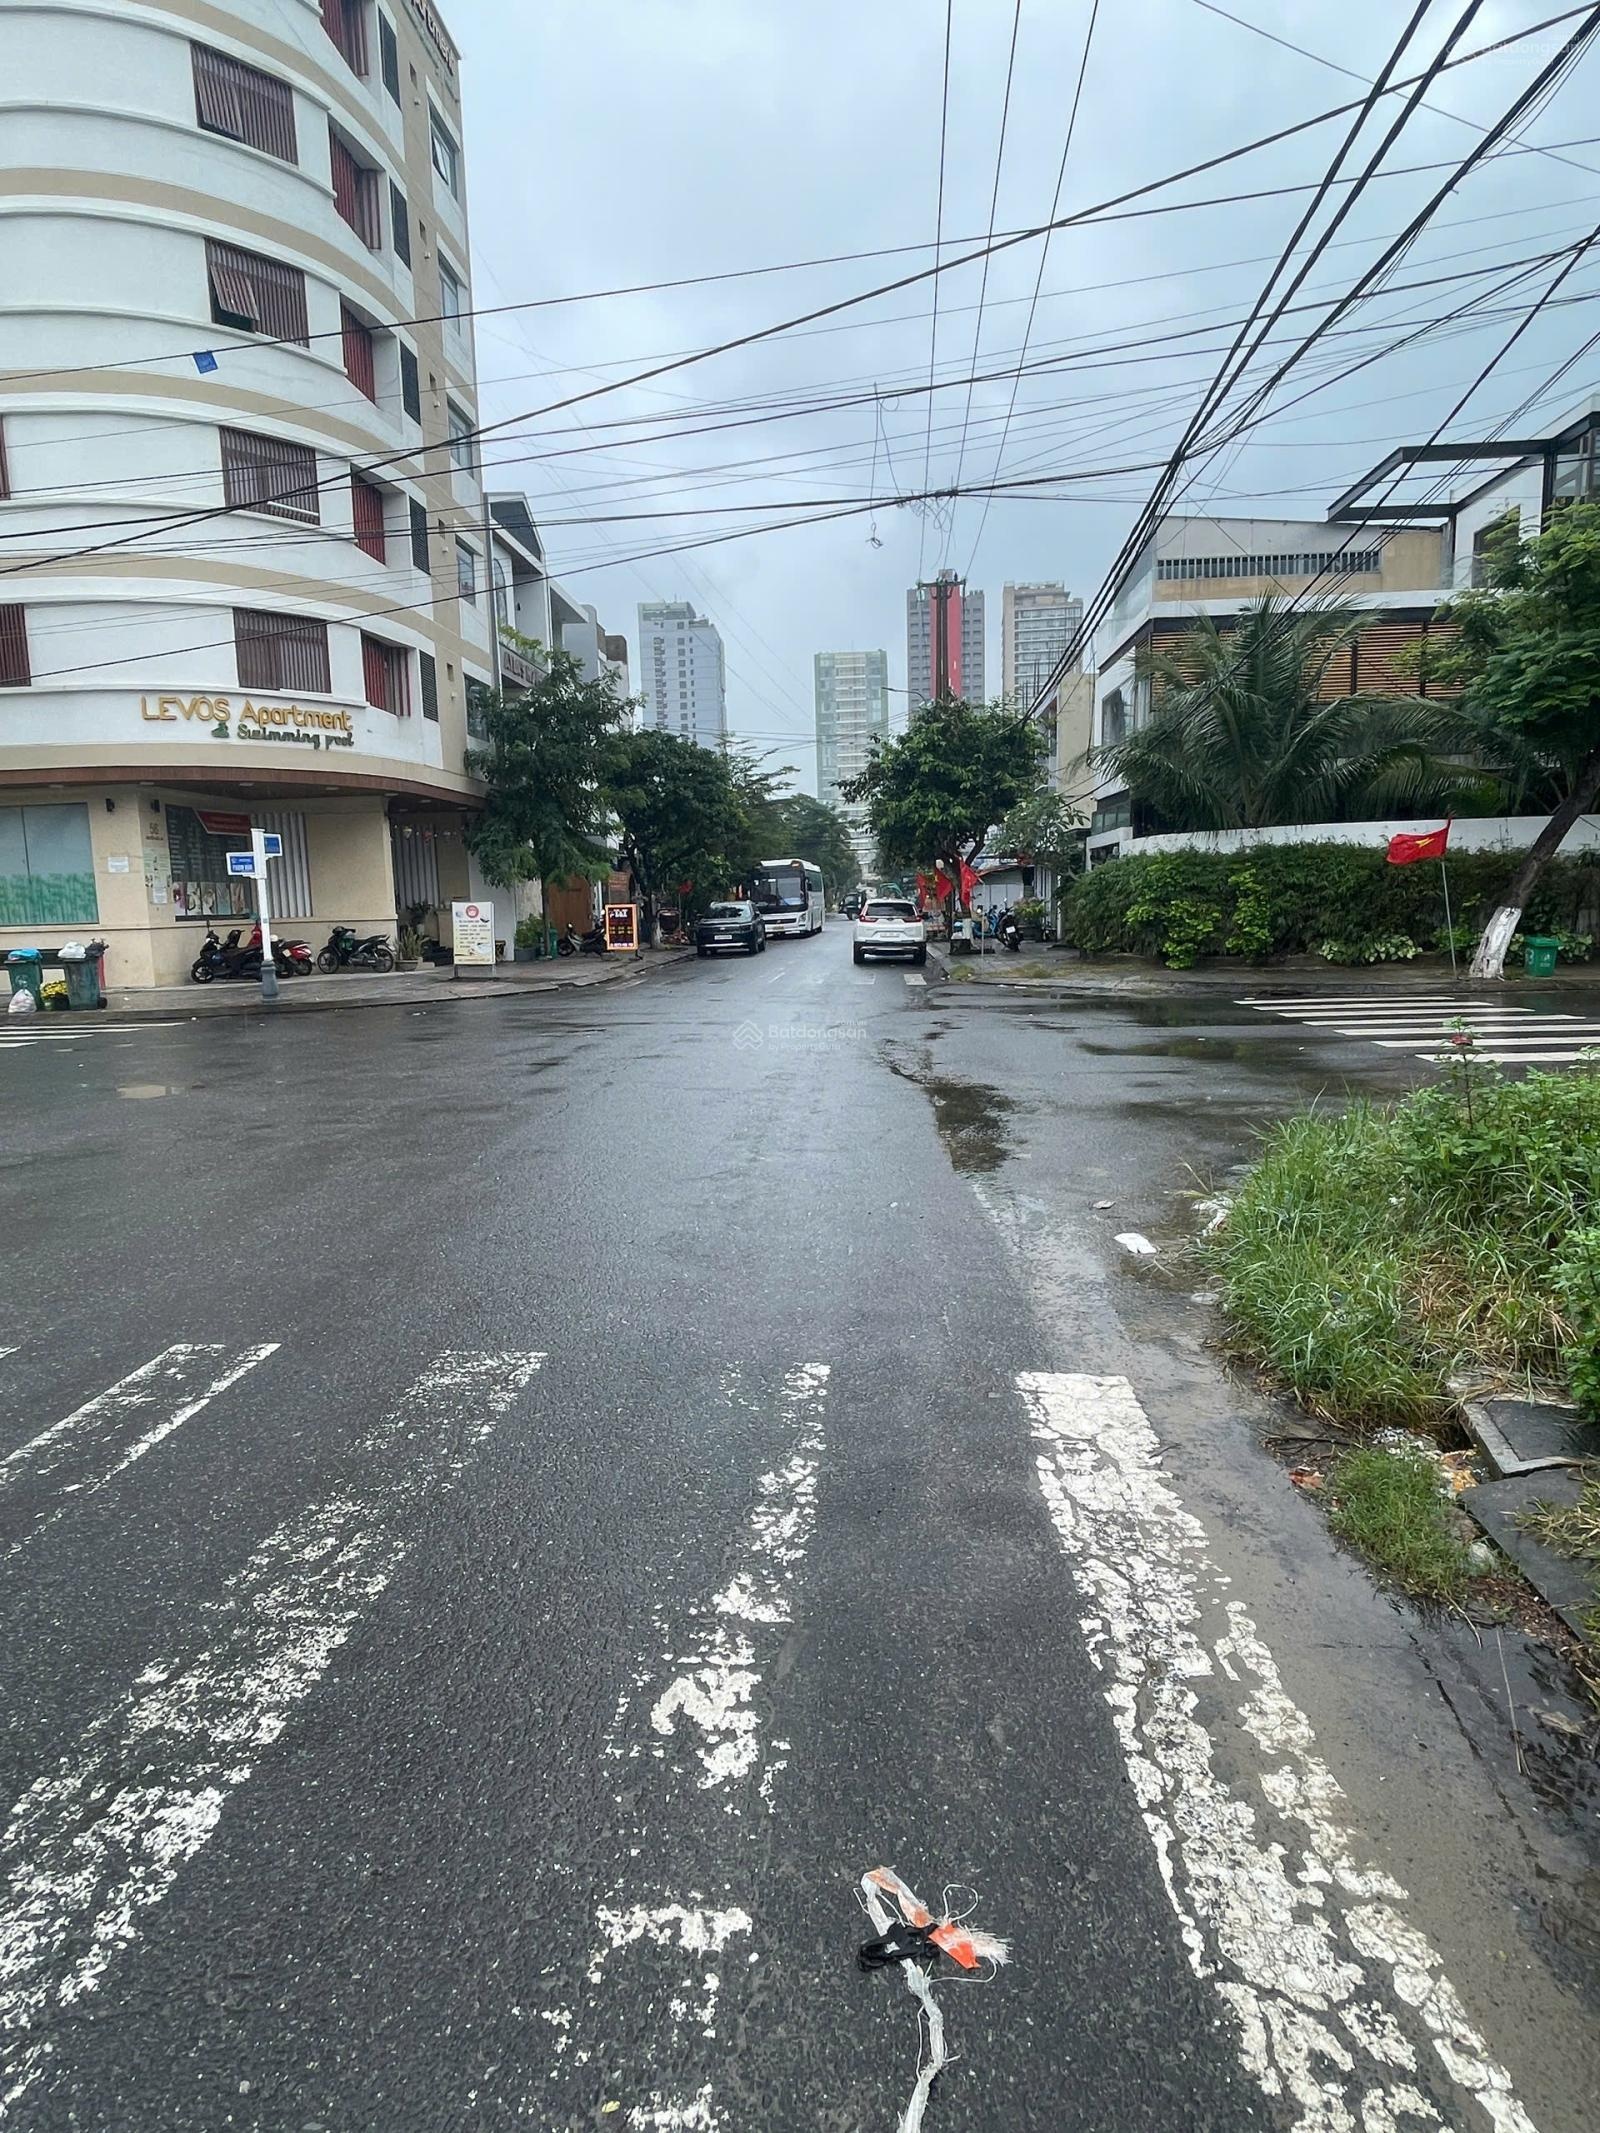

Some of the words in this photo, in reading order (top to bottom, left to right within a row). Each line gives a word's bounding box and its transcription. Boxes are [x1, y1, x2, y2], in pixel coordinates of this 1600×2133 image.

[141, 696, 231, 722] LEVOS
[239, 698, 354, 731] Apartment
[237, 723, 320, 750] Swimming
